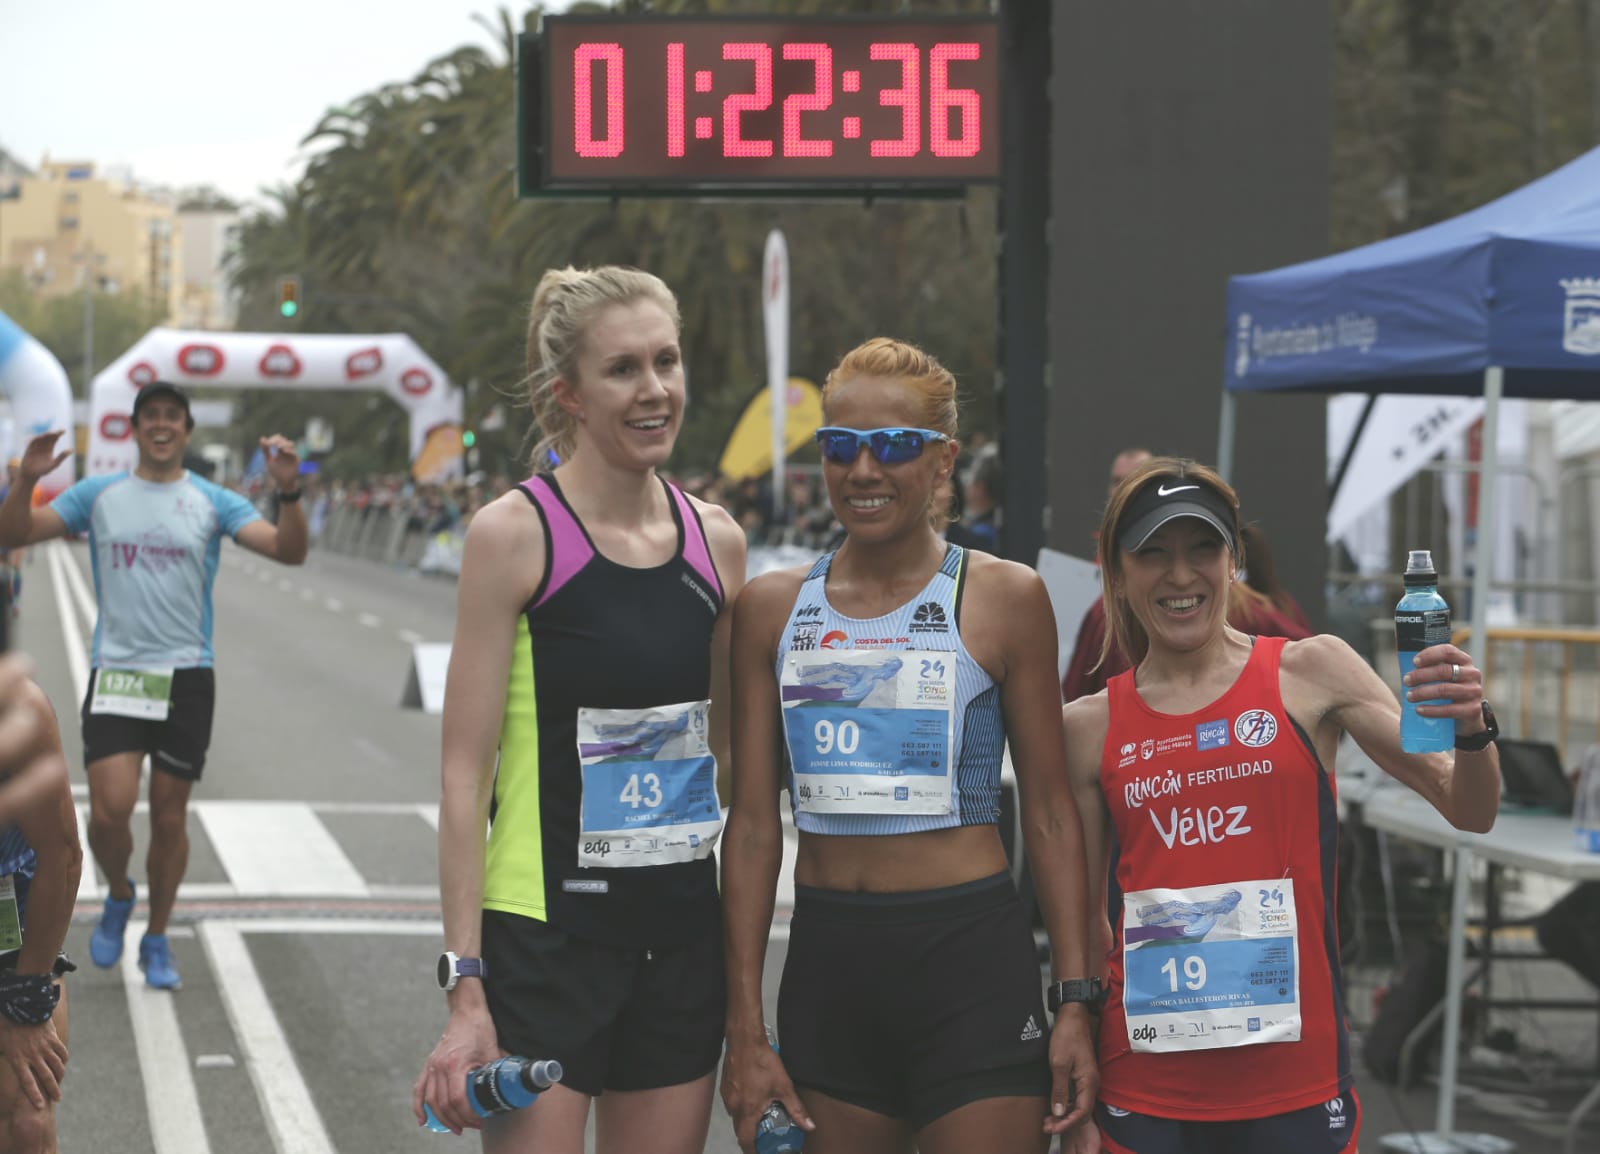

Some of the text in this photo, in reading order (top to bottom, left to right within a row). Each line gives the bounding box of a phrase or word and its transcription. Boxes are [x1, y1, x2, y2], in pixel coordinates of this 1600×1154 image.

[104, 672, 145, 692] 1374
[814, 718, 860, 755] 90
[1188, 760, 1273, 787] FERTILIDAD
[619, 773, 663, 809] 43
[584, 840, 611, 858] edp
[1160, 955, 1207, 993] 19
[1132, 1024, 1158, 1043] edp
